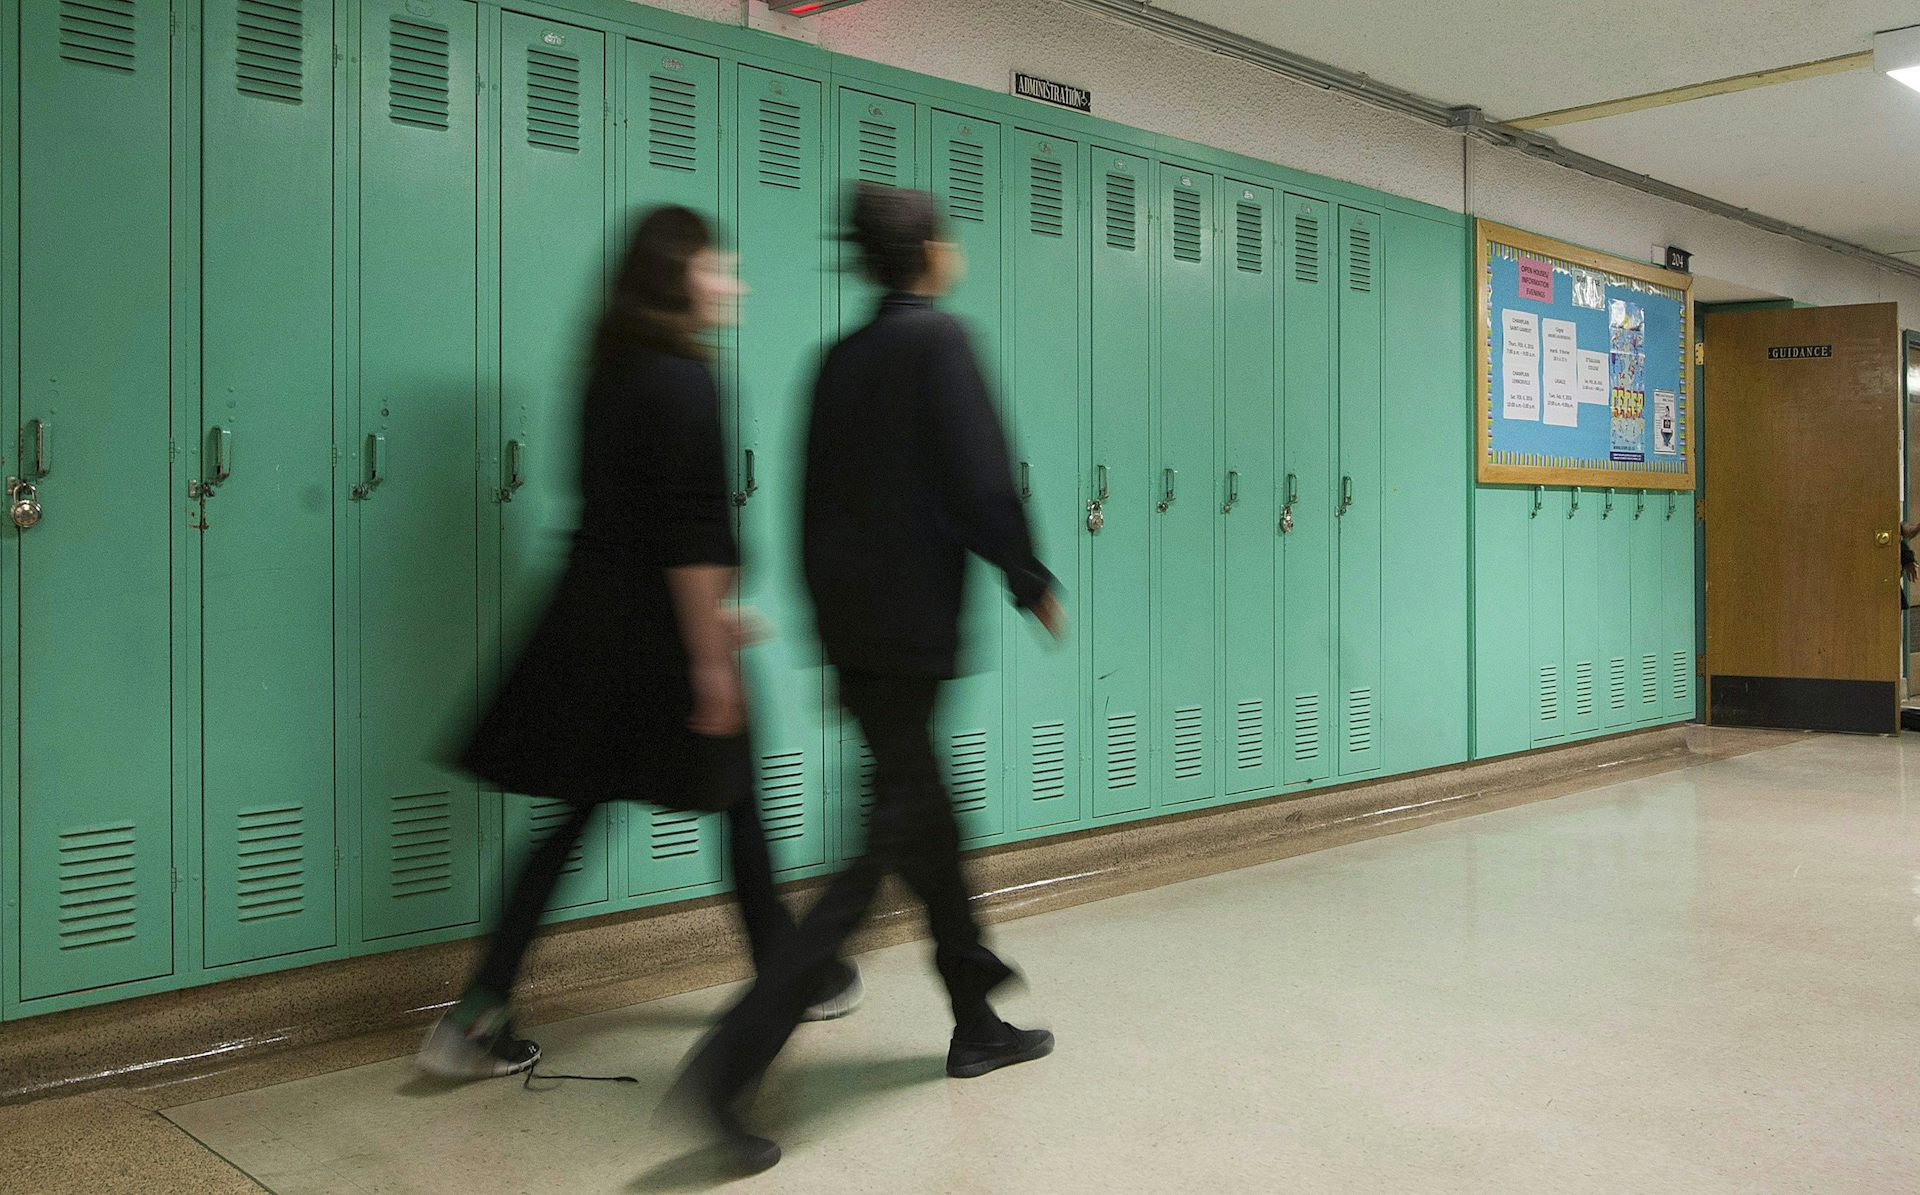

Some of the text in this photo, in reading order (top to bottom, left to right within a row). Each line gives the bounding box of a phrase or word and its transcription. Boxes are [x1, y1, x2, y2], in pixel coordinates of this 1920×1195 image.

[1018, 76, 1081, 107] ADMINISTRATION
[1521, 265, 1532, 274] OPEN
[1521, 276, 1549, 289] INFORMATION
[1772, 346, 1828, 358] GUIDANCE
